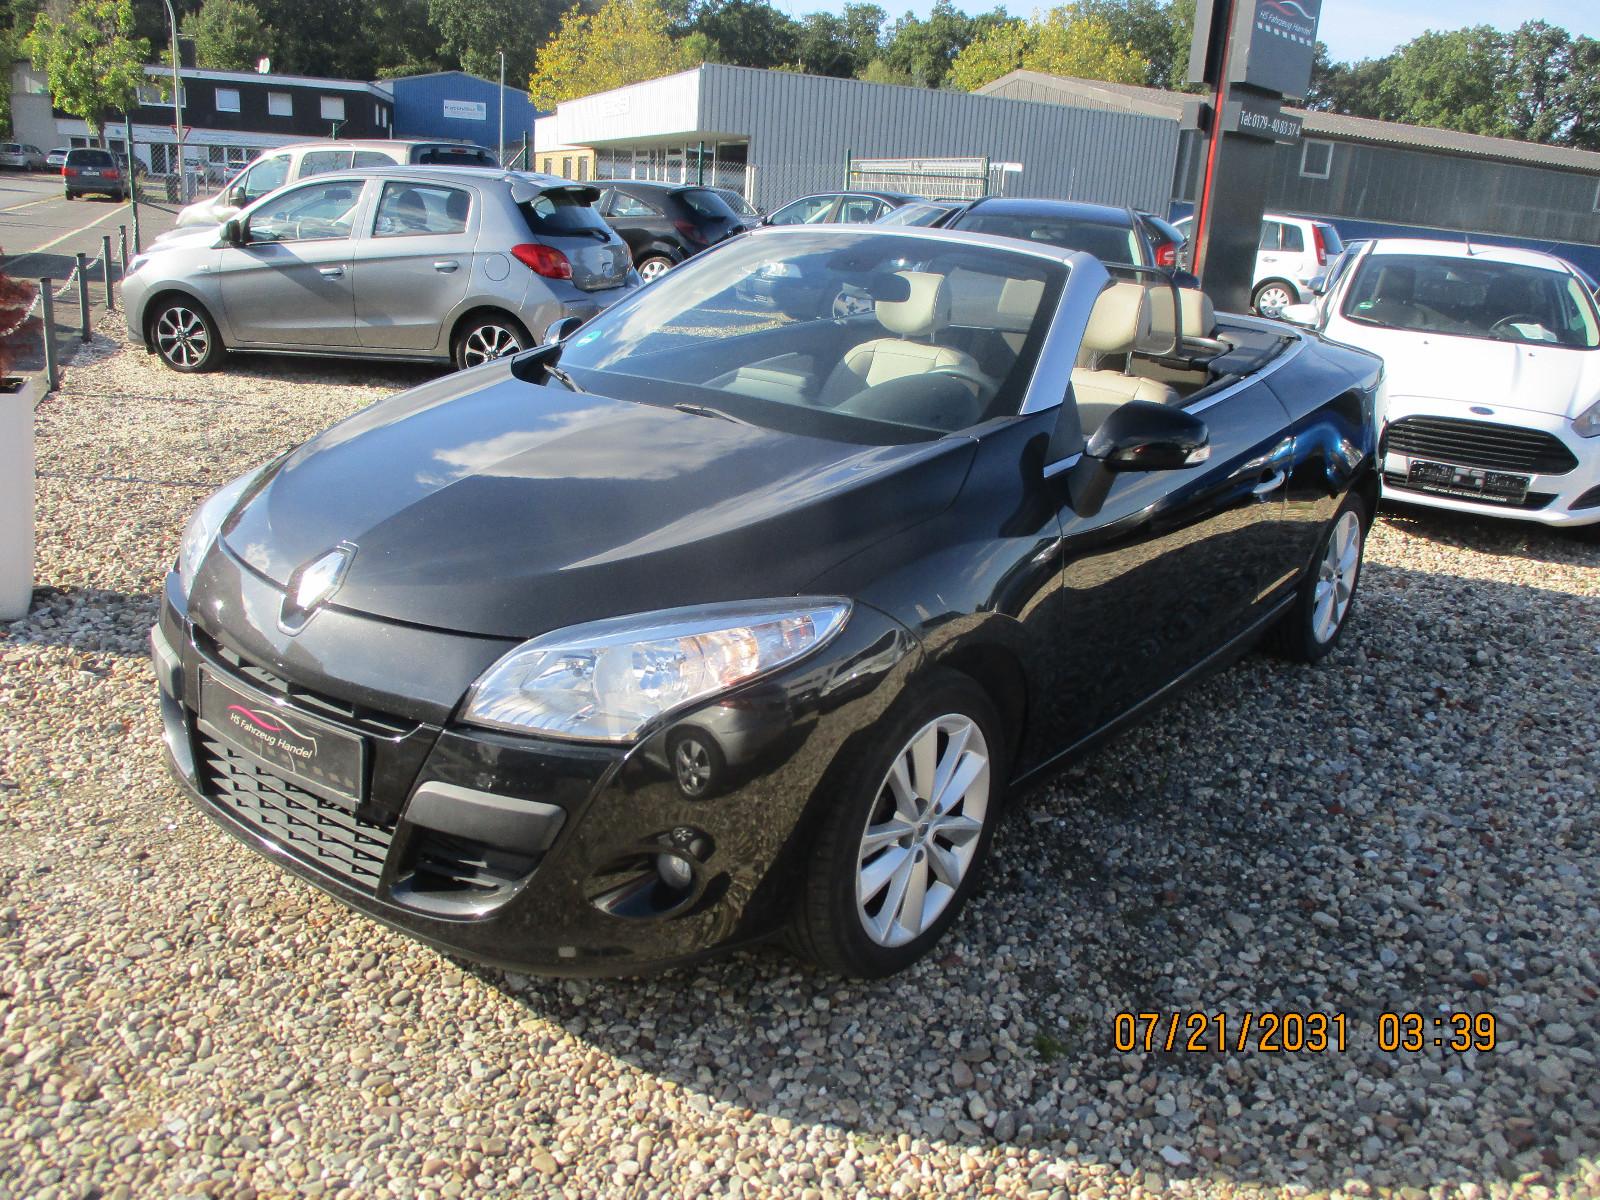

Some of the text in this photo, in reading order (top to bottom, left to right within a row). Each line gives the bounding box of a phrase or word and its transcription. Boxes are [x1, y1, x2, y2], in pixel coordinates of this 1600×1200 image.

[230, 712, 313, 759] HS Fahrzeug Handel
